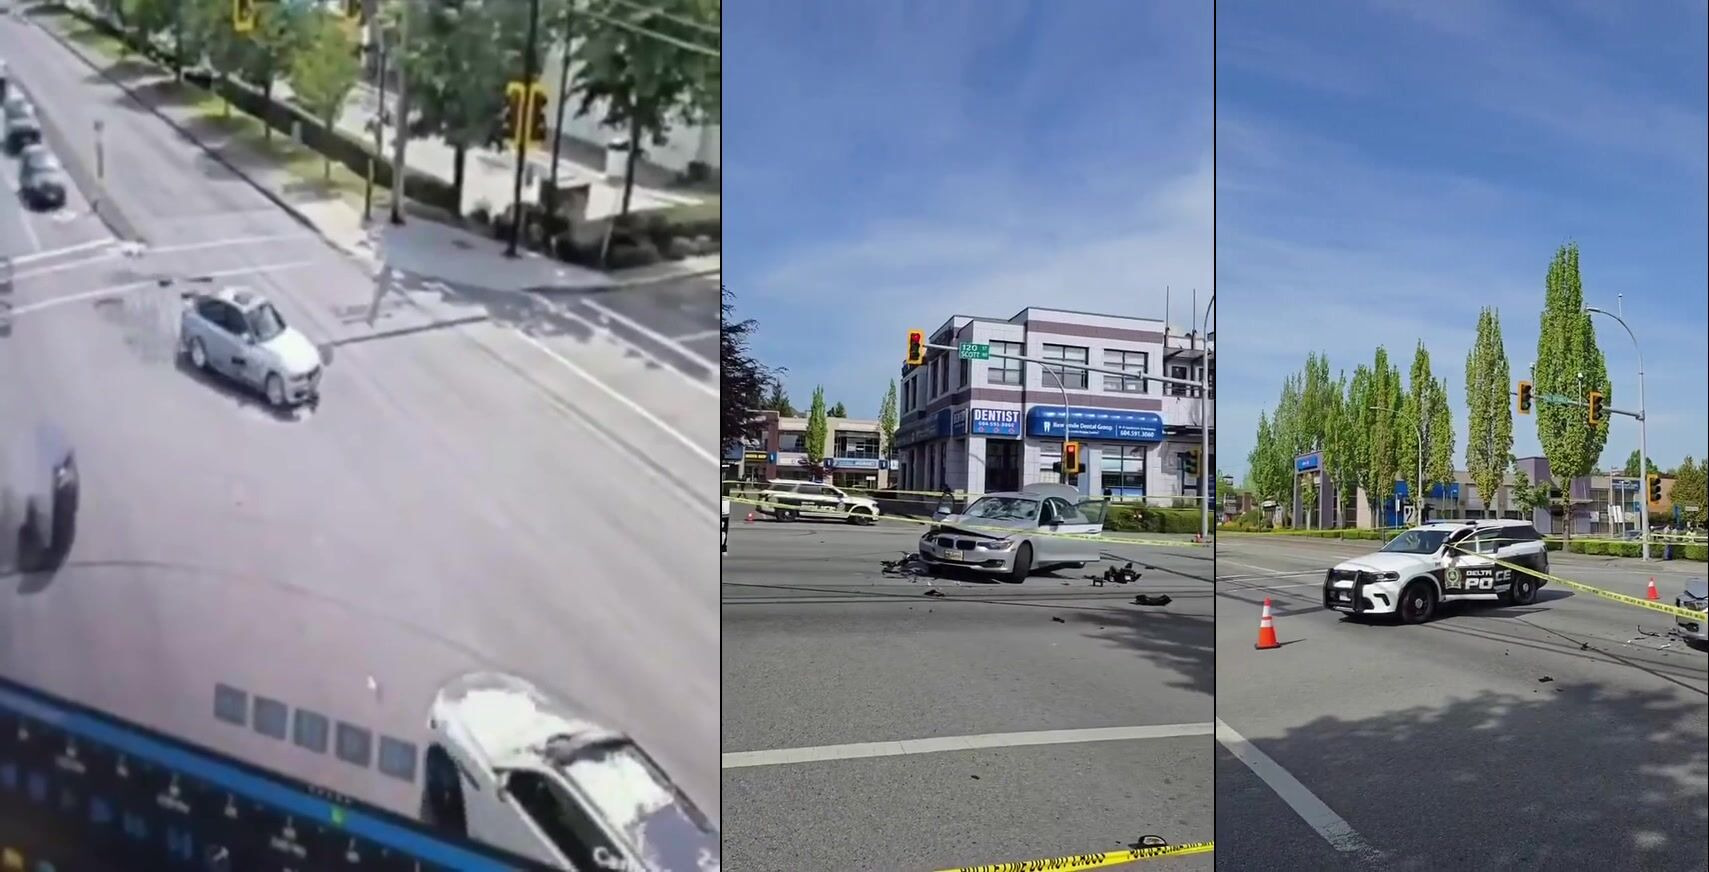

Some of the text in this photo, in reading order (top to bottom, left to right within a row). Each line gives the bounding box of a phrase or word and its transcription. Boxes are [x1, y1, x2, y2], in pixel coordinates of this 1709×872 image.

[961, 350, 980, 358] SCOTT
[974, 409, 1019, 423] DENTIST
[1097, 424, 1113, 432] Group
